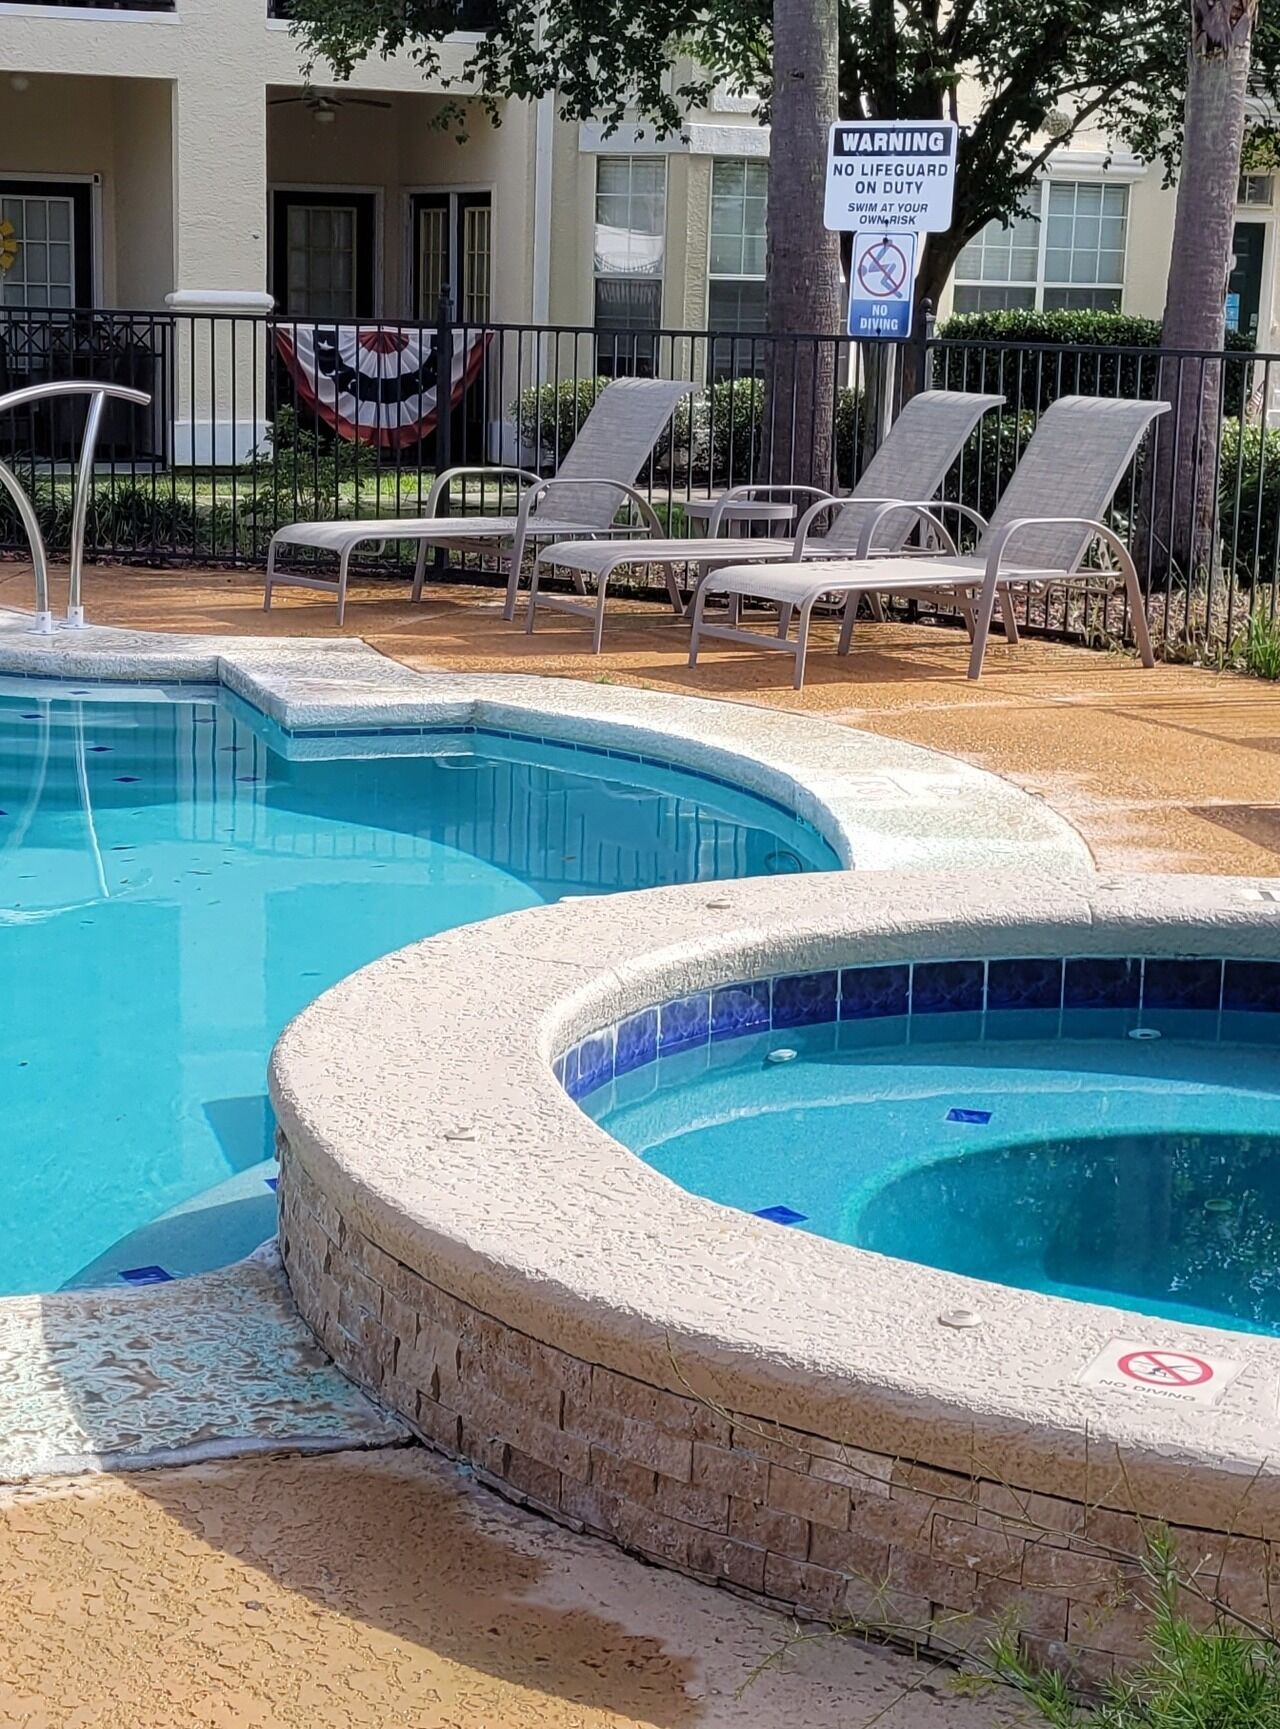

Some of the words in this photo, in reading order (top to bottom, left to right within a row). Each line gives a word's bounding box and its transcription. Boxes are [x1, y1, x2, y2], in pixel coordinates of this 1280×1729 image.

[842, 132, 944, 152] WARNING
[833, 163, 855, 176] NO
[861, 163, 948, 176] LIFEGUARD
[855, 181, 876, 194] ON
[883, 181, 924, 194] DUTY
[847, 203, 878, 212] SWIM
[880, 203, 895, 212] AT
[897, 203, 928, 213] YOUR
[859, 215, 885, 225] OWN
[889, 215, 917, 225] RISK
[871, 304, 888, 316] NO
[860, 318, 898, 330] DIVING
[1098, 1379, 1127, 1388] NO
[1133, 1385, 1196, 1401] DIVING
